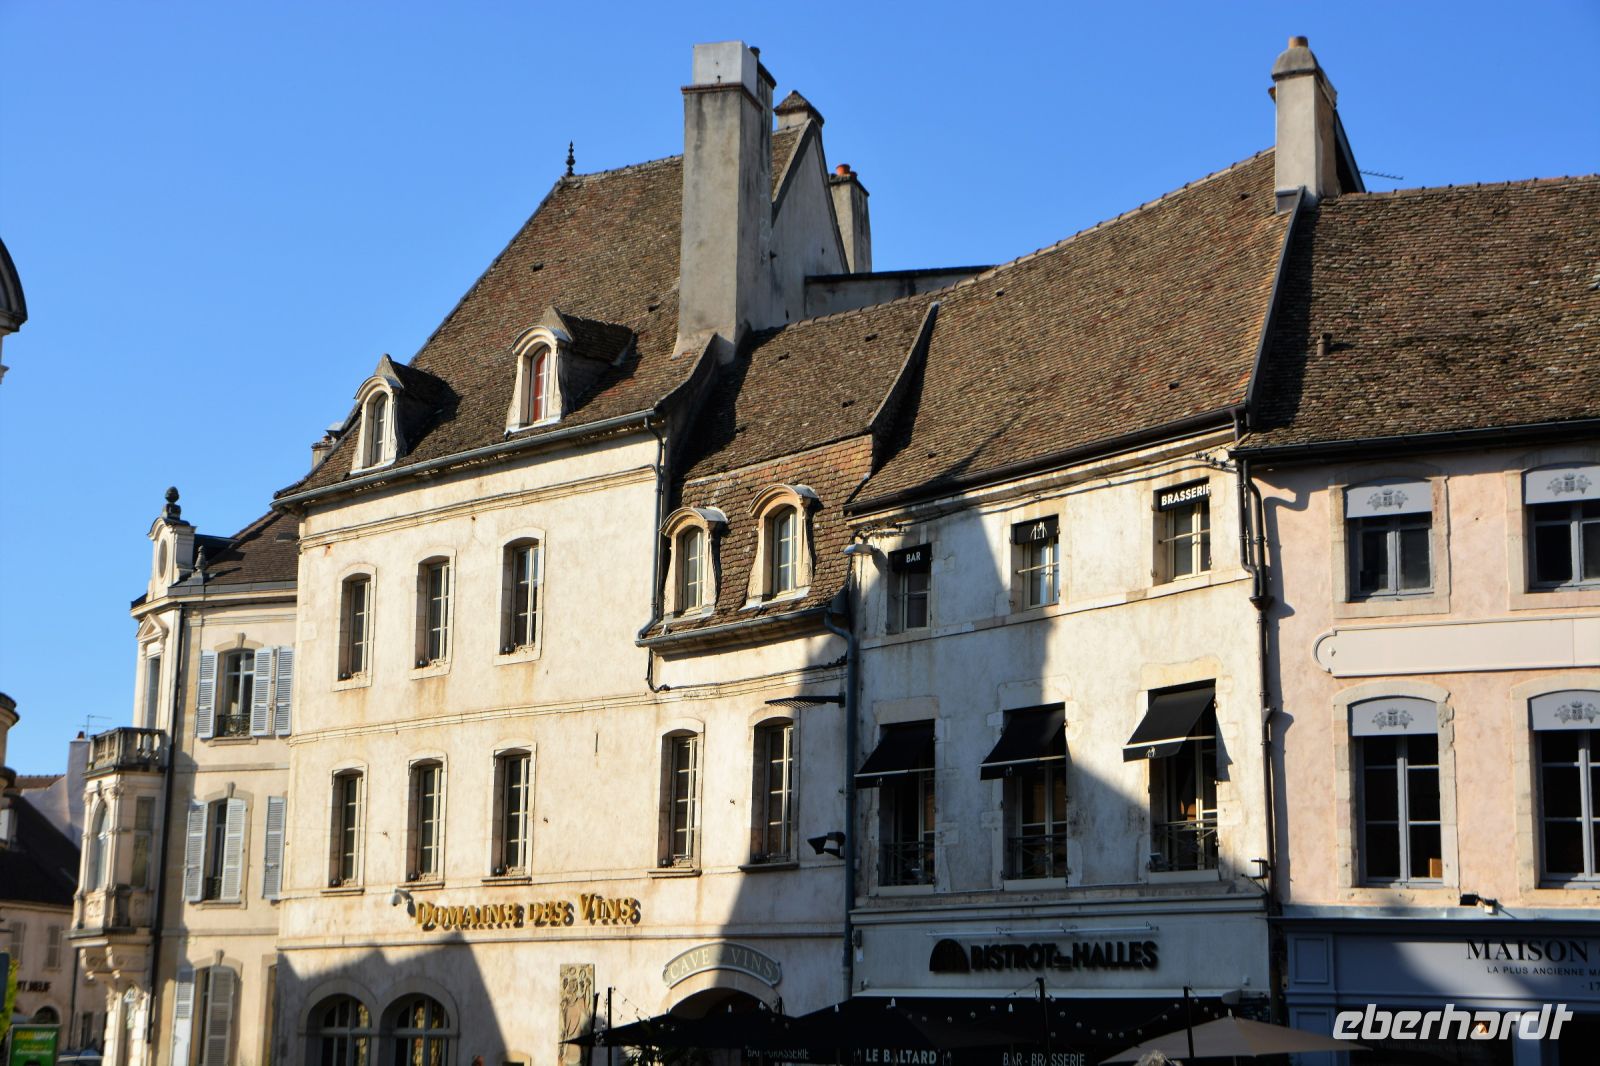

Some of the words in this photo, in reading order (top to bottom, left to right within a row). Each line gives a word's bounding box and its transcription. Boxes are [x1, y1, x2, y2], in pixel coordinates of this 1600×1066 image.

[1161, 483, 1211, 507] BRASSERIE
[906, 551, 921, 563] BAR
[415, 900, 519, 927] DOMAINE
[528, 899, 568, 925] DES
[577, 892, 634, 921] VINS
[970, 942, 1057, 970] BISTROT
[1071, 940, 1159, 969] HALLES
[1466, 937, 1590, 963] MAISON
[669, 948, 711, 980] CAVE
[730, 947, 774, 979] VINS
[1486, 966, 1499, 974] LA
[1503, 966, 1529, 975] PLUS
[1534, 967, 1586, 976] ANCIENNE
[865, 1047, 879, 1063] LE
